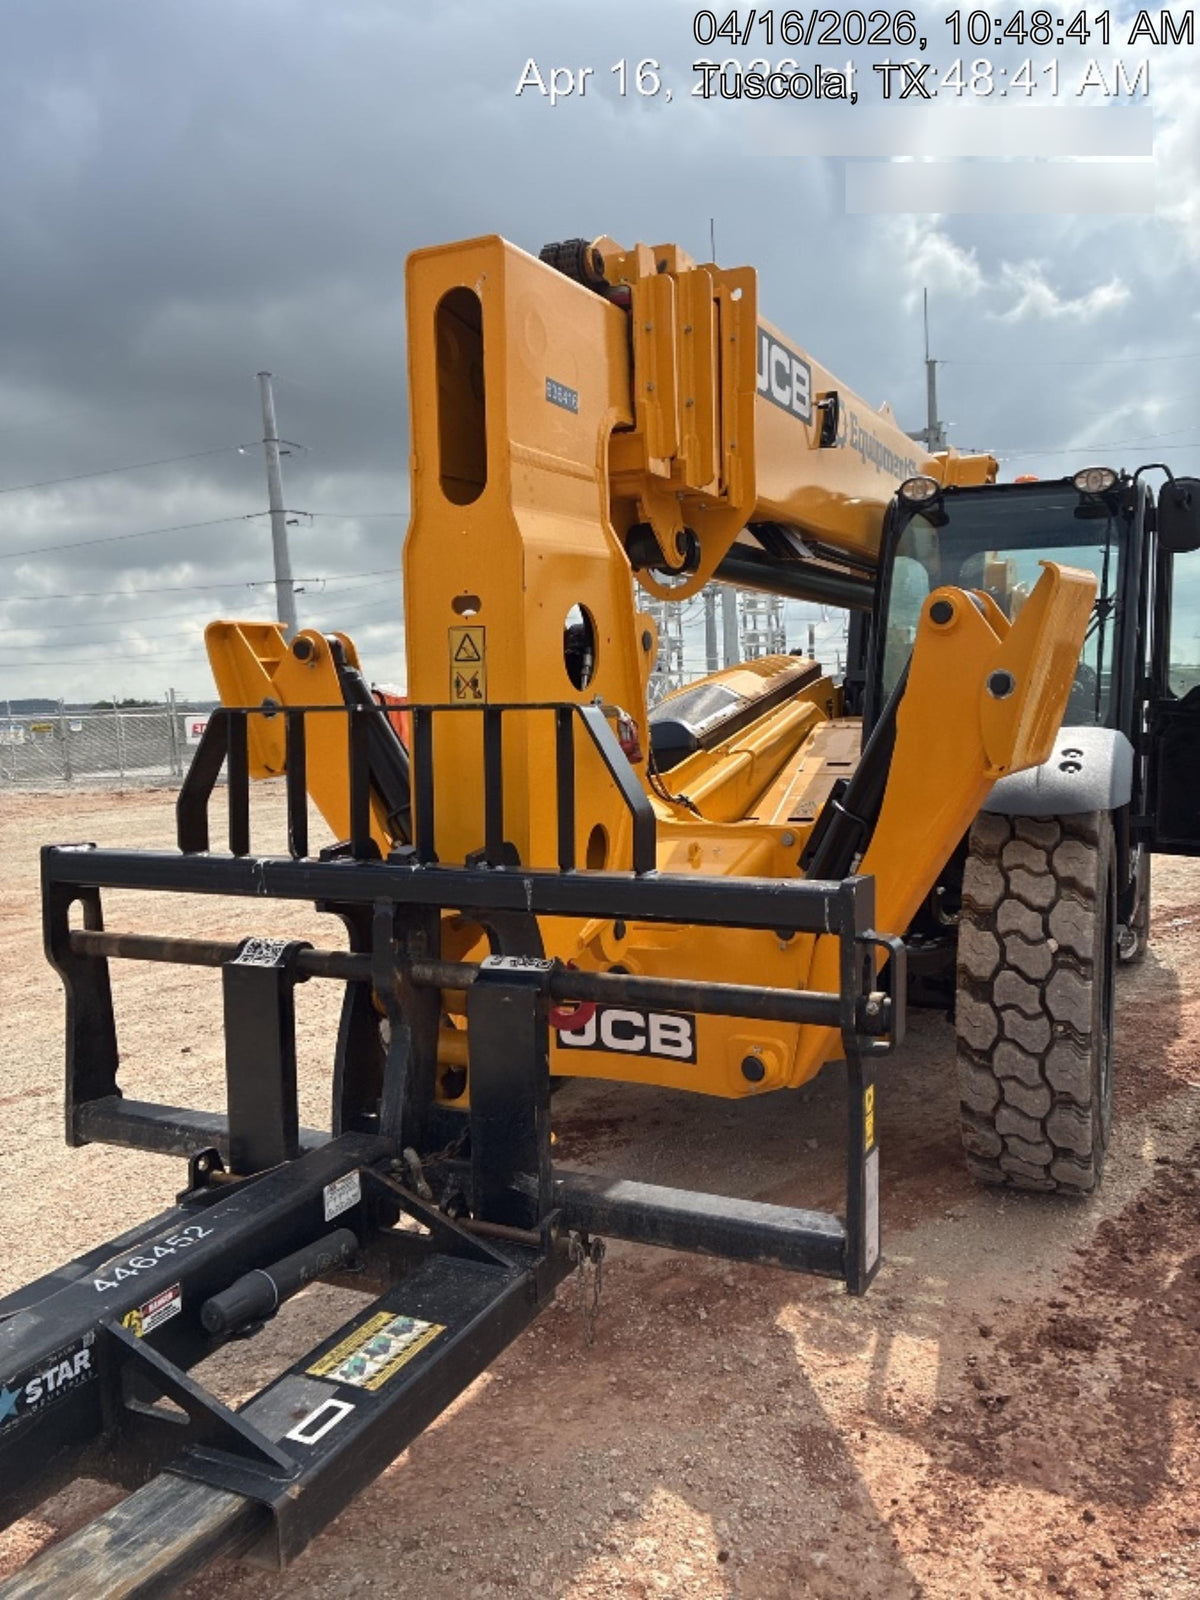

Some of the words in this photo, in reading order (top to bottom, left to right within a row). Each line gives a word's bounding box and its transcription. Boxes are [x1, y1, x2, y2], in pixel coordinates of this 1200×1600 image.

[757, 335, 810, 419] JCB
[559, 1008, 693, 1059] JCB
[93, 1226, 214, 1292] 446452
[25, 1349, 92, 1404] STAR
